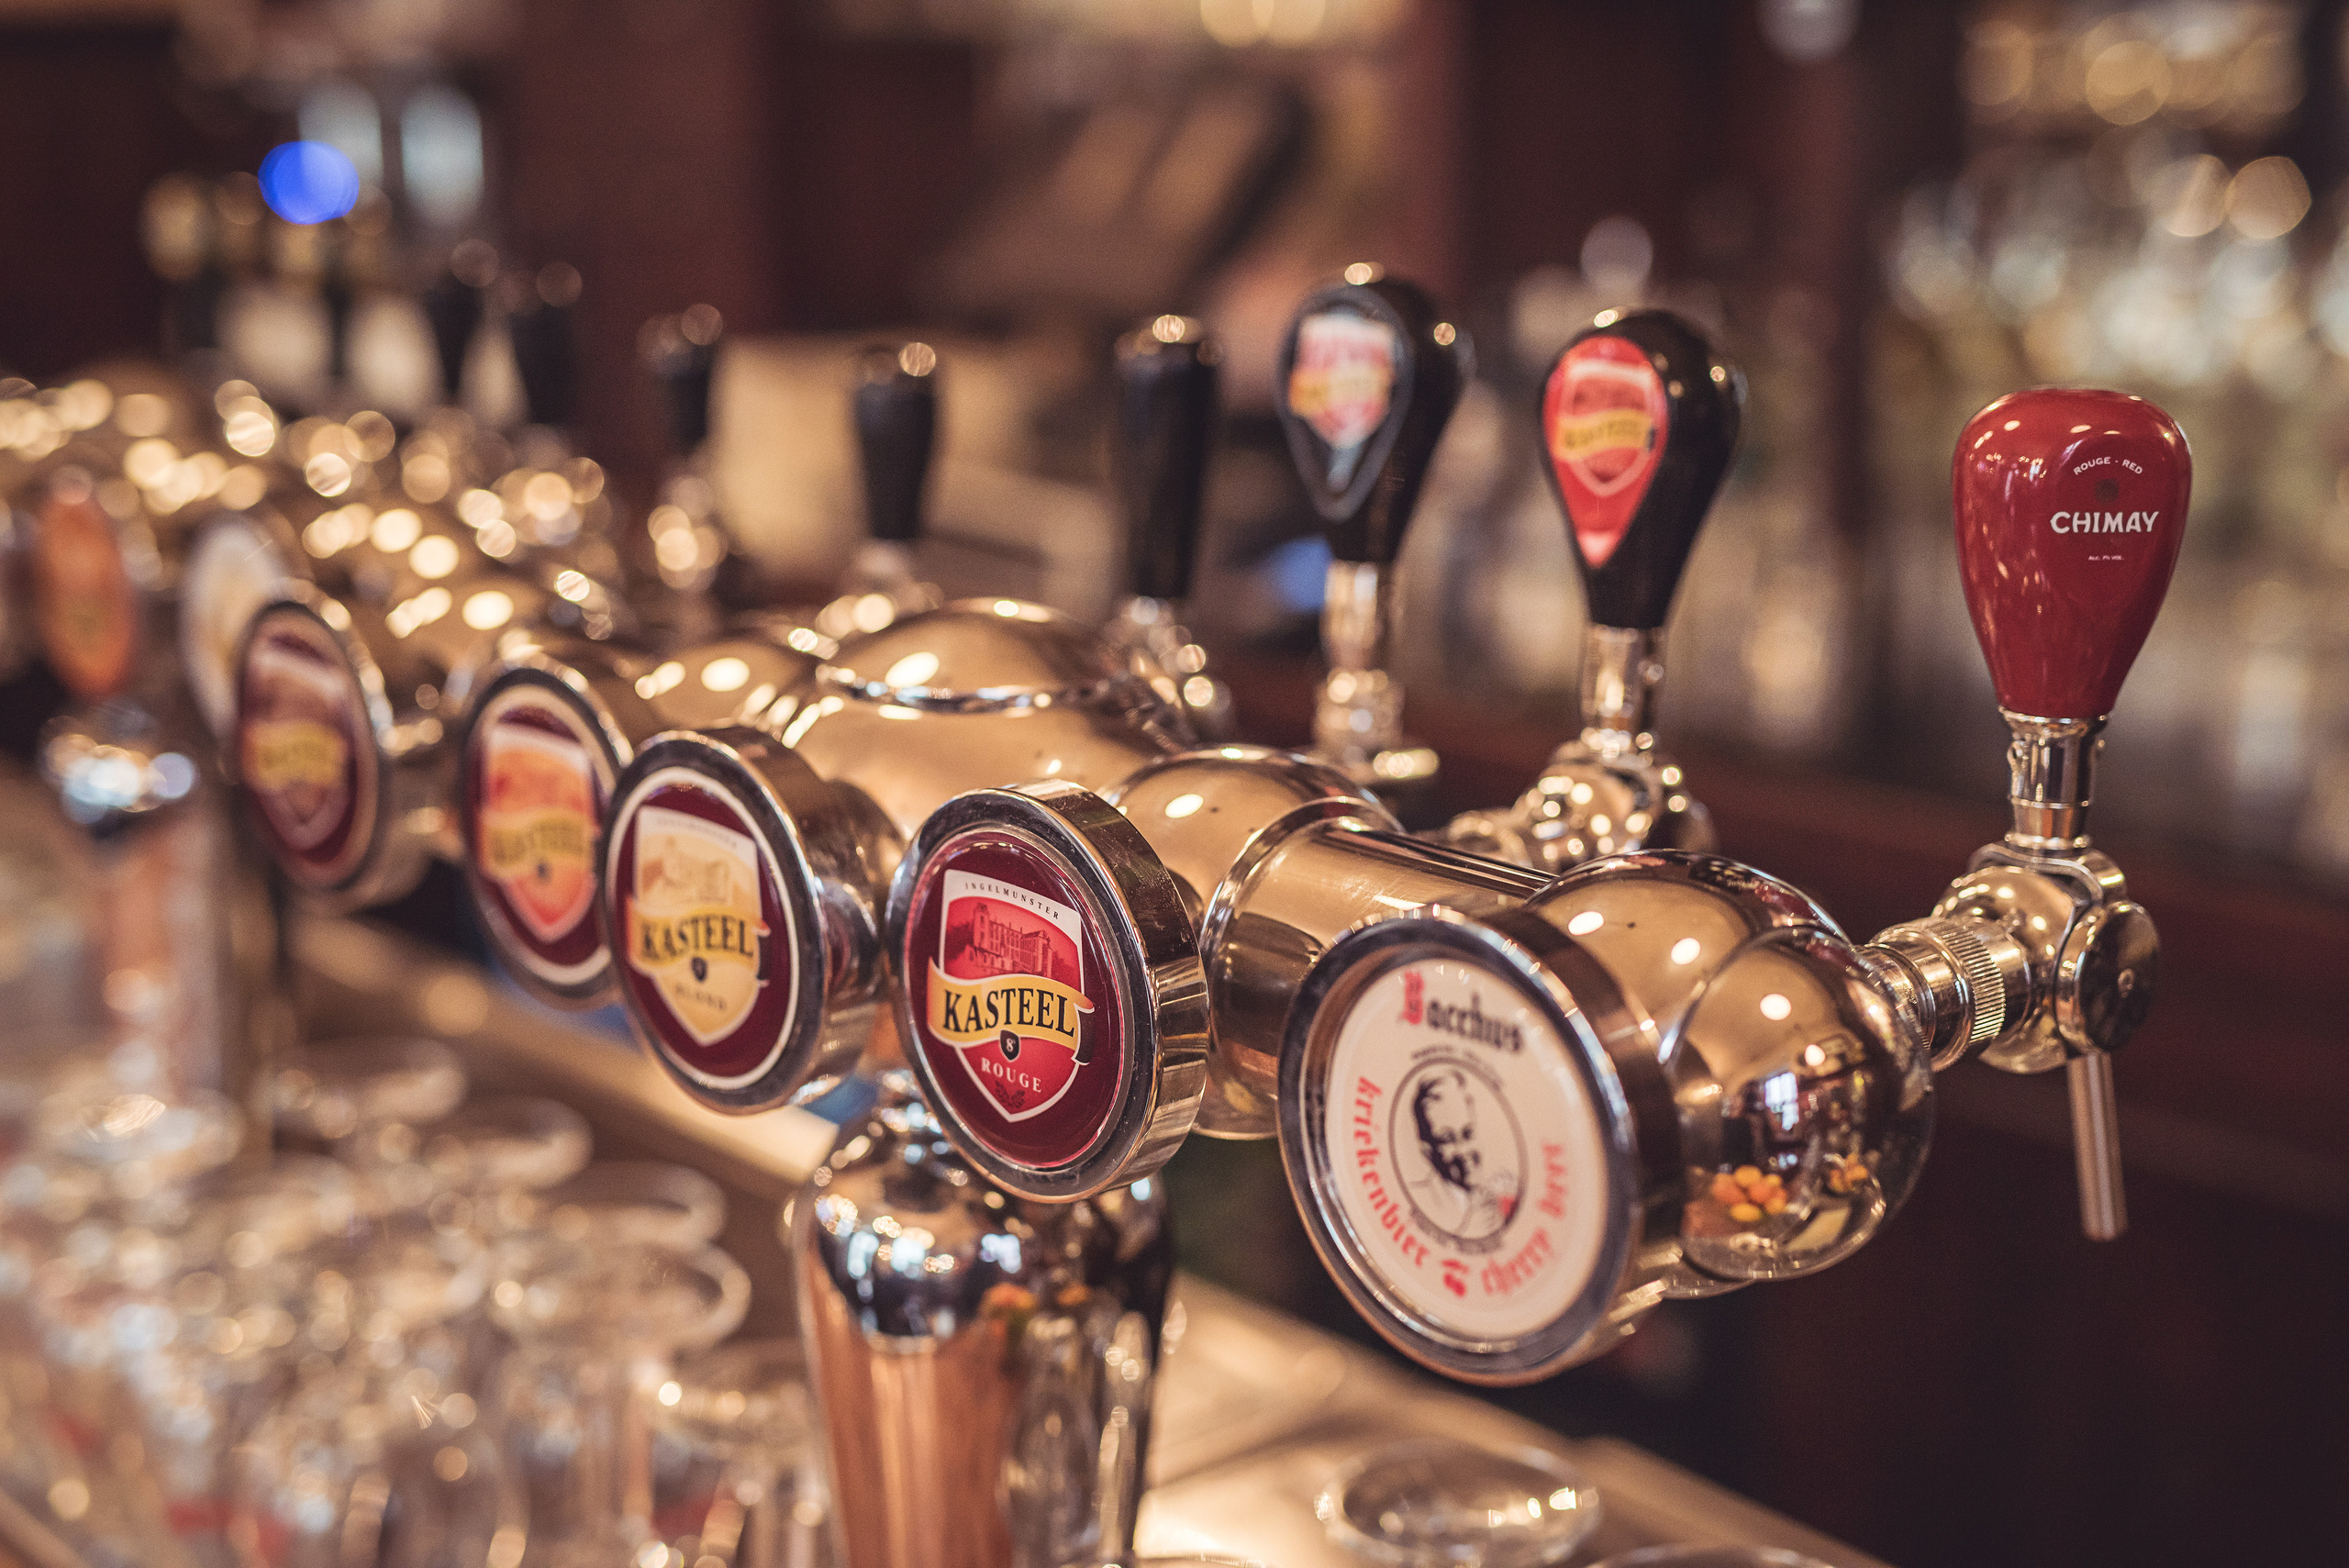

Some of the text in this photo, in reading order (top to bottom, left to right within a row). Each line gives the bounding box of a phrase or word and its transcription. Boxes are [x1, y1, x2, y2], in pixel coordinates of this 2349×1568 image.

[2074, 457, 2143, 475] ROUGE RED
[2050, 511, 2159, 534] CHIMAY
[965, 882, 1059, 919] INGELMUNSTER
[640, 914, 754, 961] KASTEEL
[943, 988, 1075, 1038] KASTEEL
[981, 1057, 1042, 1093] ROUGE
